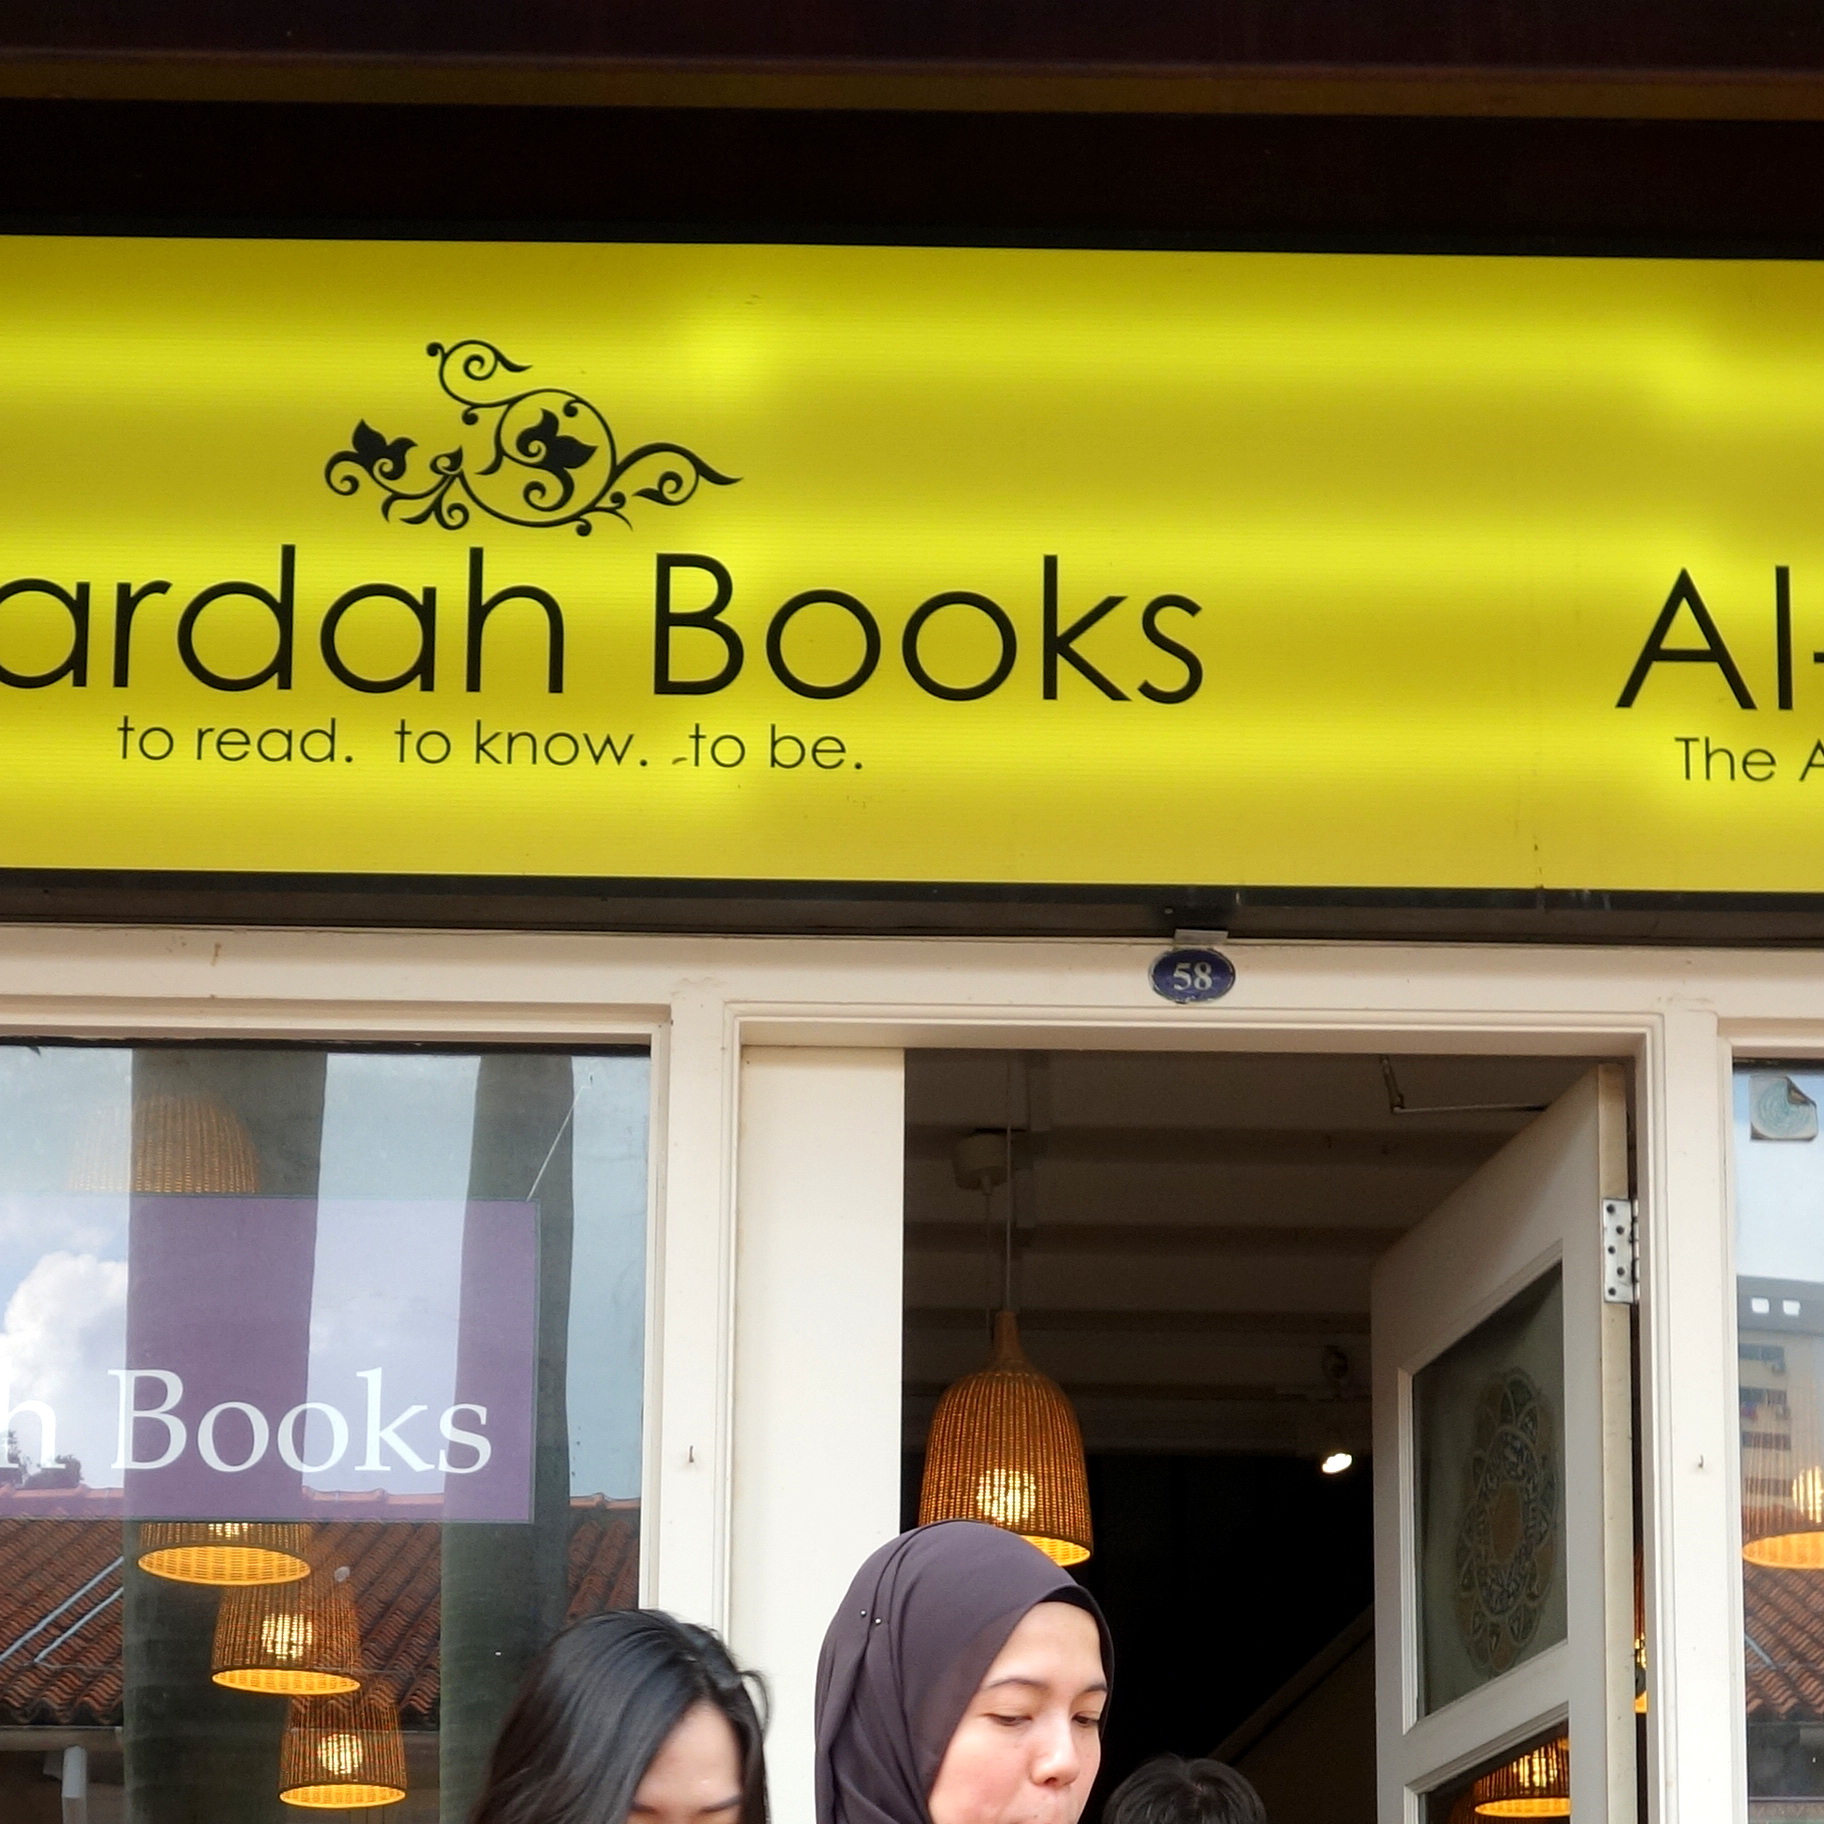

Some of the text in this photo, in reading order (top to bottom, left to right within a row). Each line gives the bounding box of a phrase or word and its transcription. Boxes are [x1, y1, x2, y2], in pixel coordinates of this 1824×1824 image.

[652, 552, 1206, 706] Books
[116, 713, 866, 774] to read. to know. to be.
[1674, 736, 1777, 784] The
[1173, 962, 1213, 991] 58
[108, 1367, 492, 1475] Books
